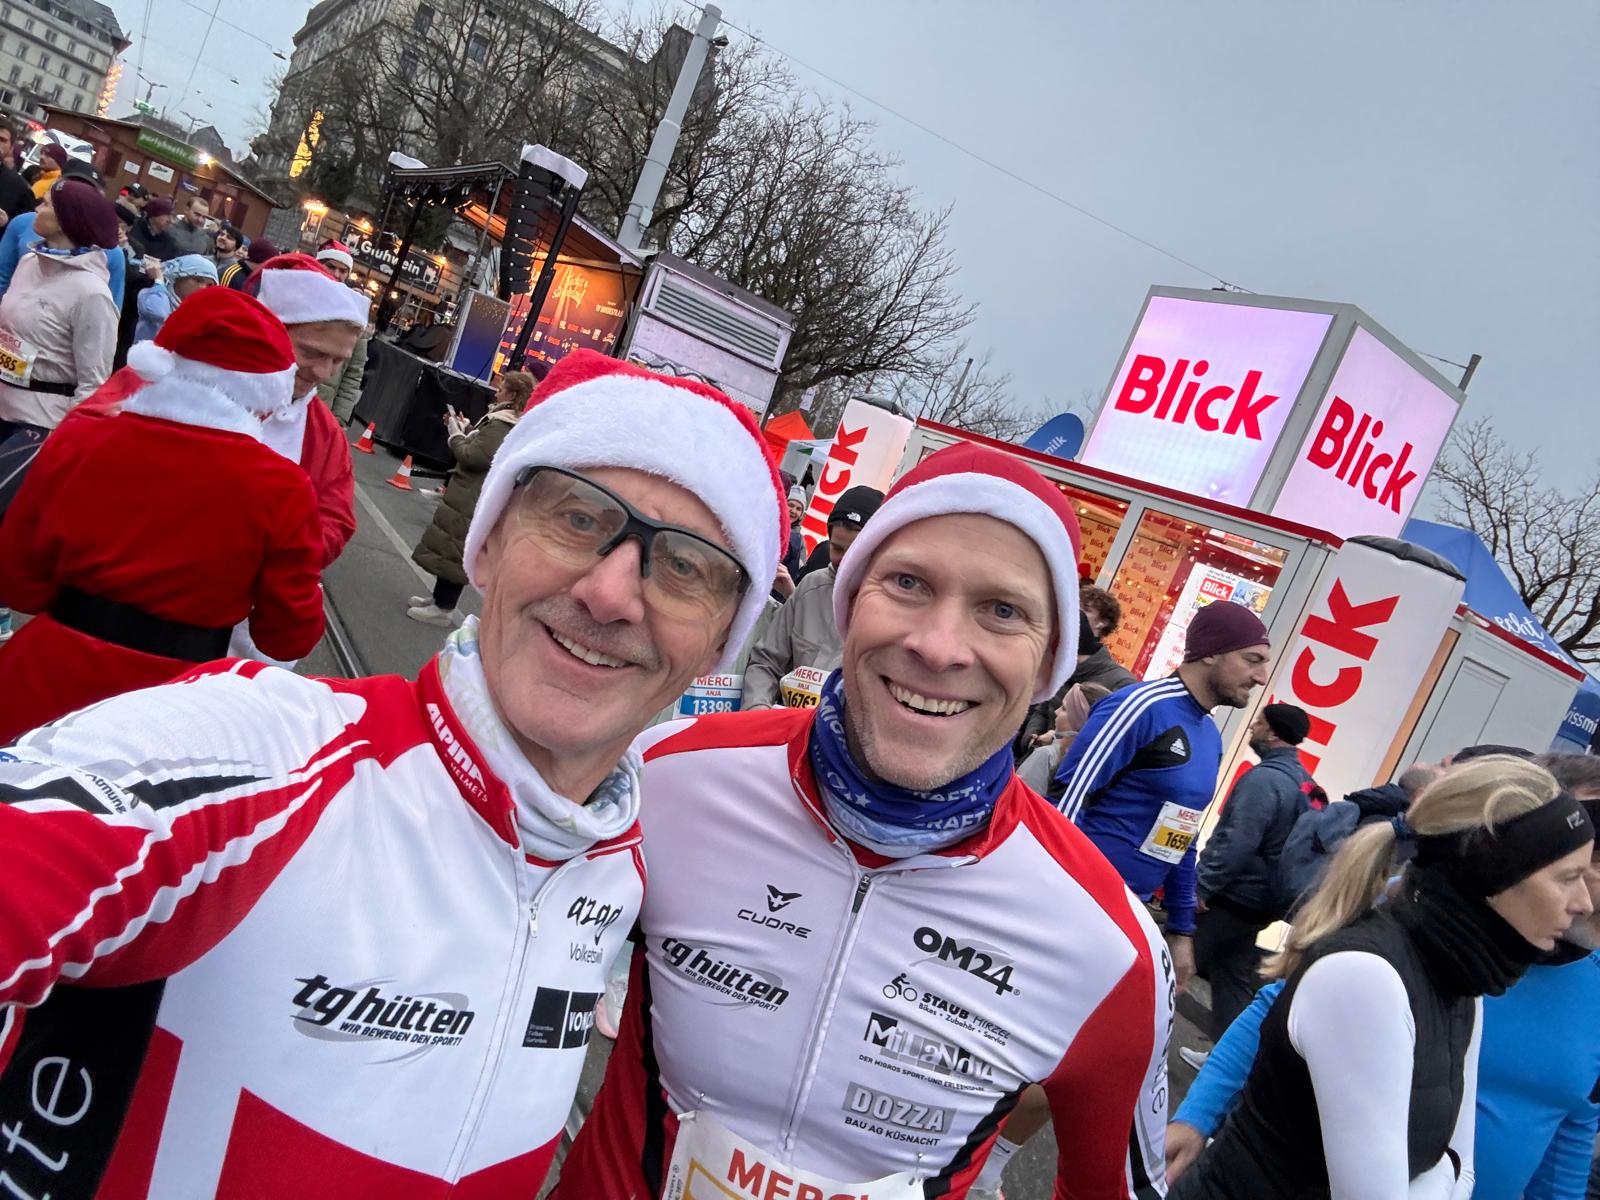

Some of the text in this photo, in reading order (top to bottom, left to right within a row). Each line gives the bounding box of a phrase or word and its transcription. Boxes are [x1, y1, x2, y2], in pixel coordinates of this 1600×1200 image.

[1114, 354, 1280, 441] Blick
[1306, 395, 1417, 515] Blick
[1201, 580, 1230, 599] Blick
[696, 676, 732, 687] MERCI
[794, 667, 823, 683] MERCI
[692, 700, 733, 715] 13398
[737, 908, 812, 939] CUORE
[684, 967, 779, 1013] WIR BEWEGEN DEN SPORT!
[689, 949, 790, 1006] hütten
[289, 974, 475, 1036] tg hütten
[921, 992, 1011, 1040] STAUB HIRZEL
[339, 1020, 464, 1048] WIR BEWEGEN DEN SPORT!
[918, 1003, 1007, 1047] Bikes Zubehör Service
[858, 1054, 874, 1065] DER
[874, 1059, 902, 1073] MIGROS
[851, 1087, 946, 1134] DOZZA
[844, 1116, 941, 1147] BAU AG KÜSNACHT
